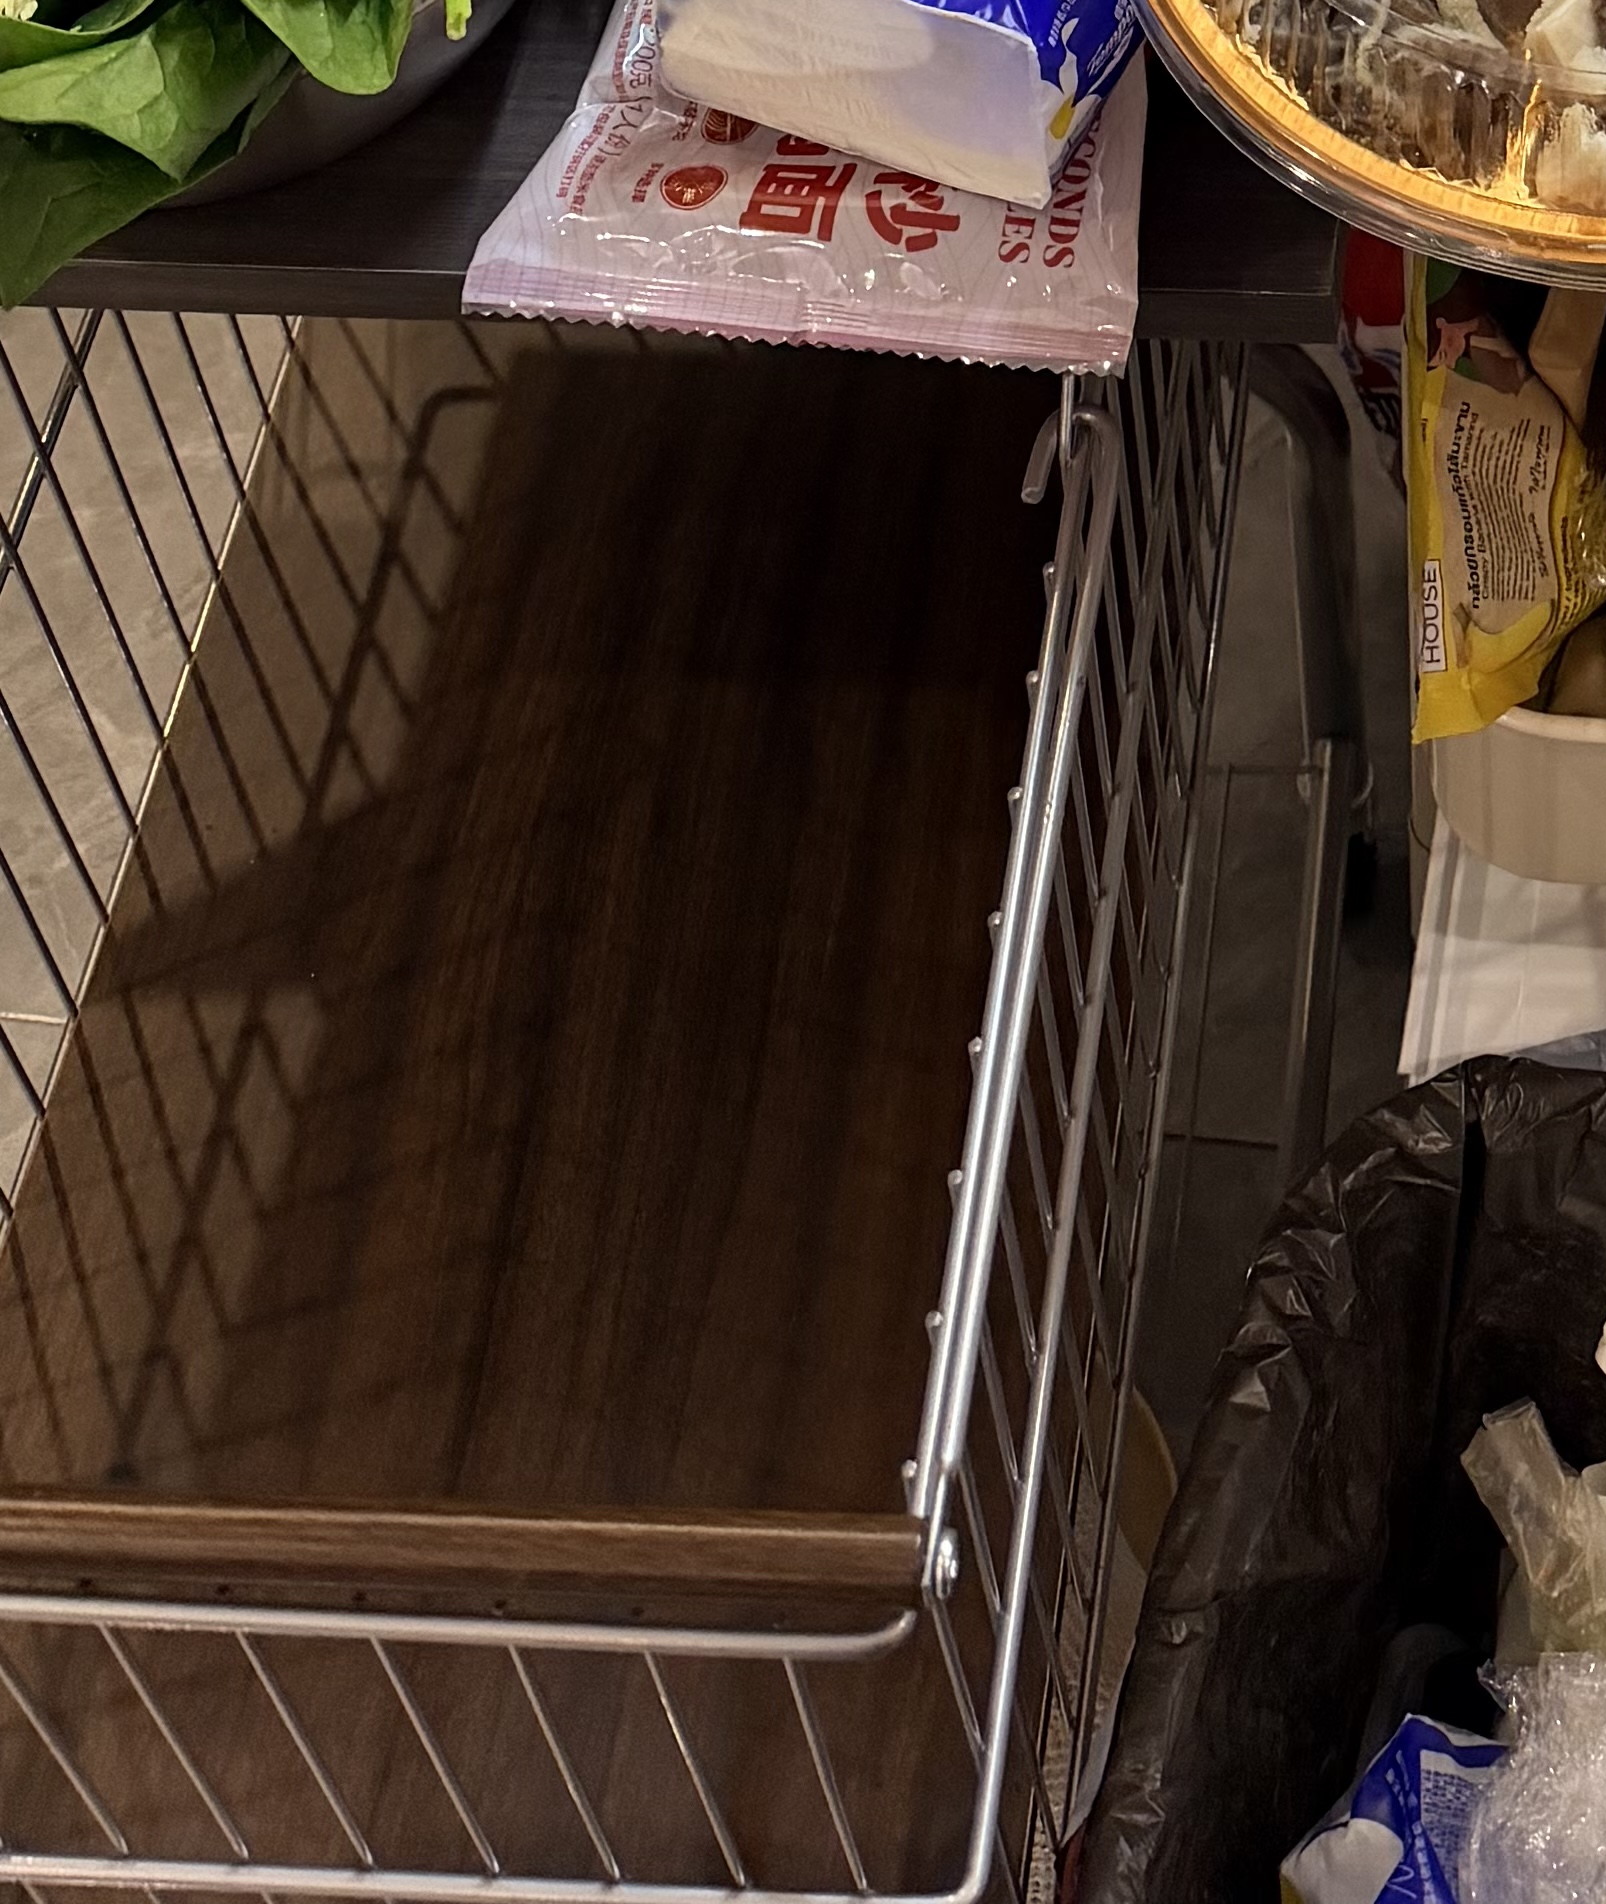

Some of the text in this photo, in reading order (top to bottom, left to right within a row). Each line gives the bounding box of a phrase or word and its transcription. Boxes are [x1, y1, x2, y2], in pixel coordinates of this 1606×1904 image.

[1462, 473, 1475, 501] with
[1471, 503, 1486, 553] Banana
[1420, 568, 1442, 663] HOUSE
